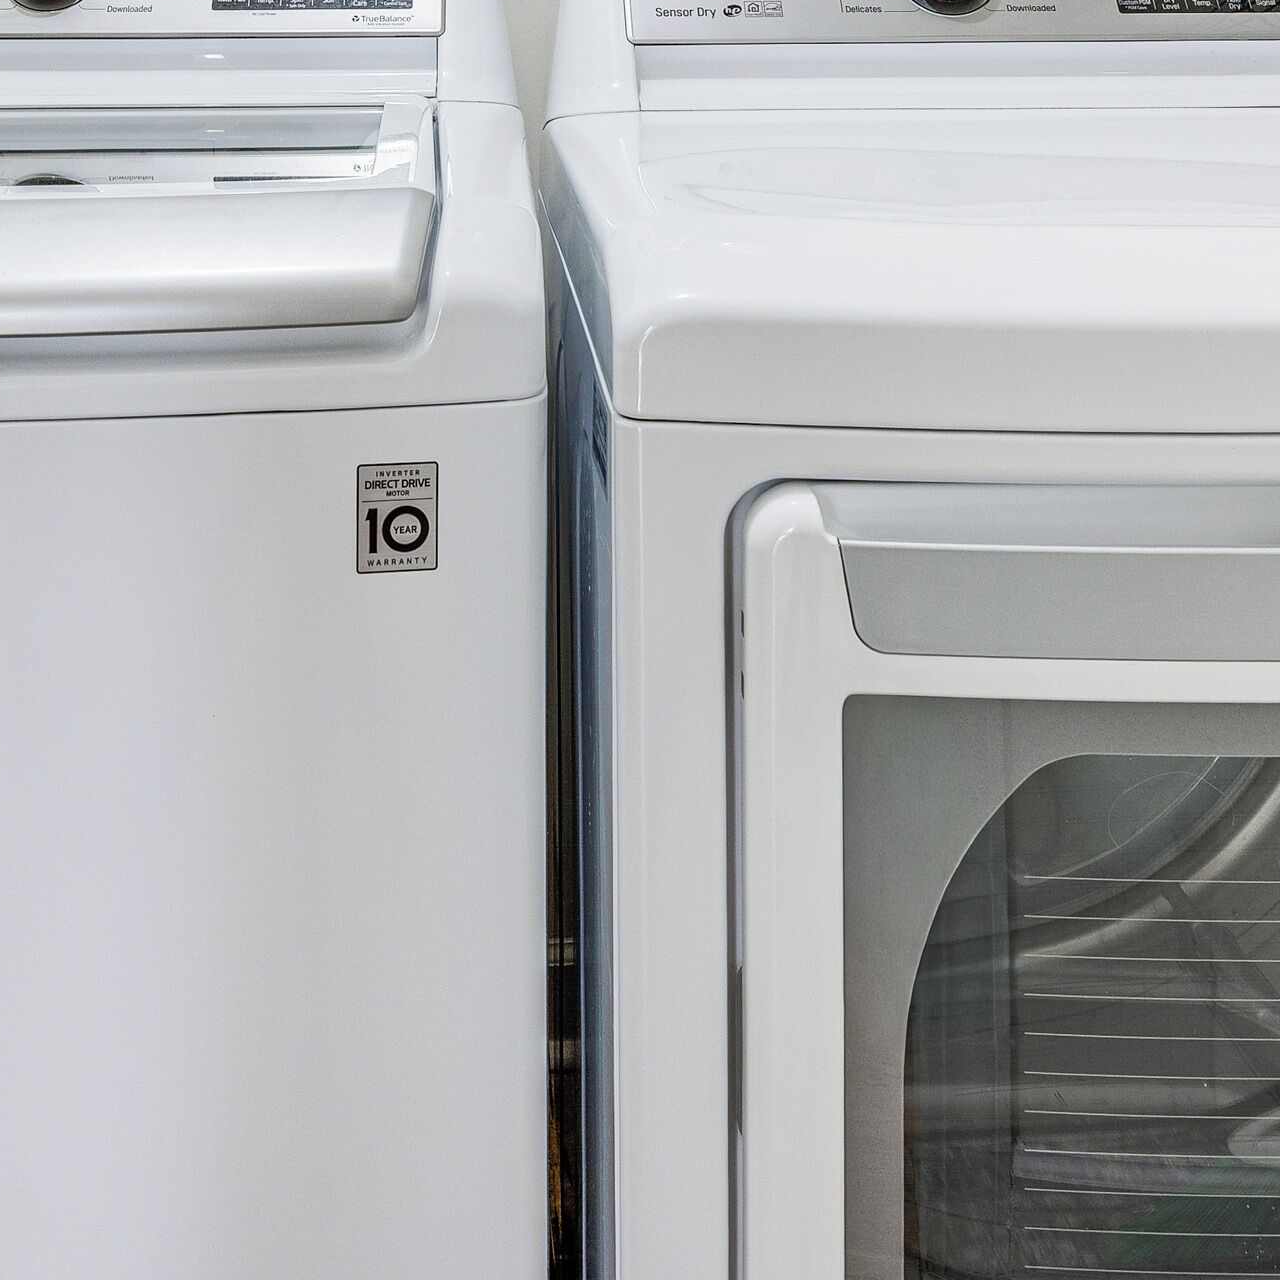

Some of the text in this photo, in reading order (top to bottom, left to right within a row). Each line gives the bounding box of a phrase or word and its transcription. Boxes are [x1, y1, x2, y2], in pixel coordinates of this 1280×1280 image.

[107, 5, 152, 13] Downloaded
[656, 8, 716, 18] Sensor Dry
[365, 478, 430, 489] DIRECT DRIVE
[365, 505, 429, 554] 10
[393, 526, 417, 534] YEAR
[367, 557, 427, 566] WARRANTY
